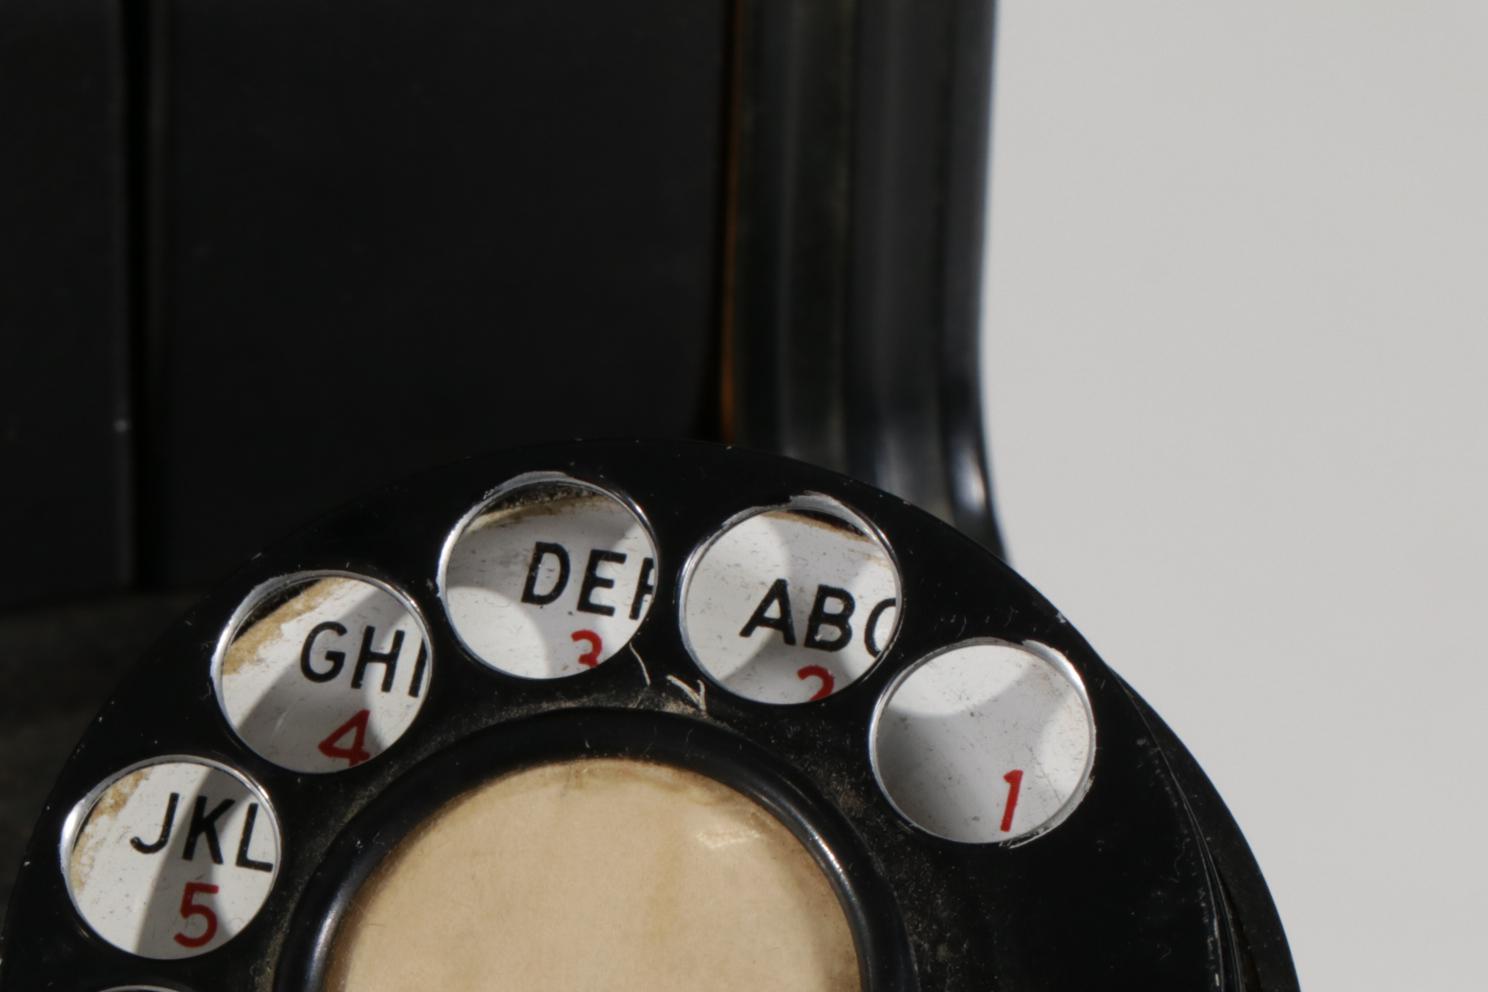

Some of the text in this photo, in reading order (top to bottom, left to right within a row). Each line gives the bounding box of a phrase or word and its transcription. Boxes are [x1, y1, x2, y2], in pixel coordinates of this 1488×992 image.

[300, 621, 428, 699] GHI
[318, 709, 370, 767] 4
[130, 792, 273, 873] JKL
[1000, 769, 1023, 832] 1
[174, 882, 219, 948] 5
